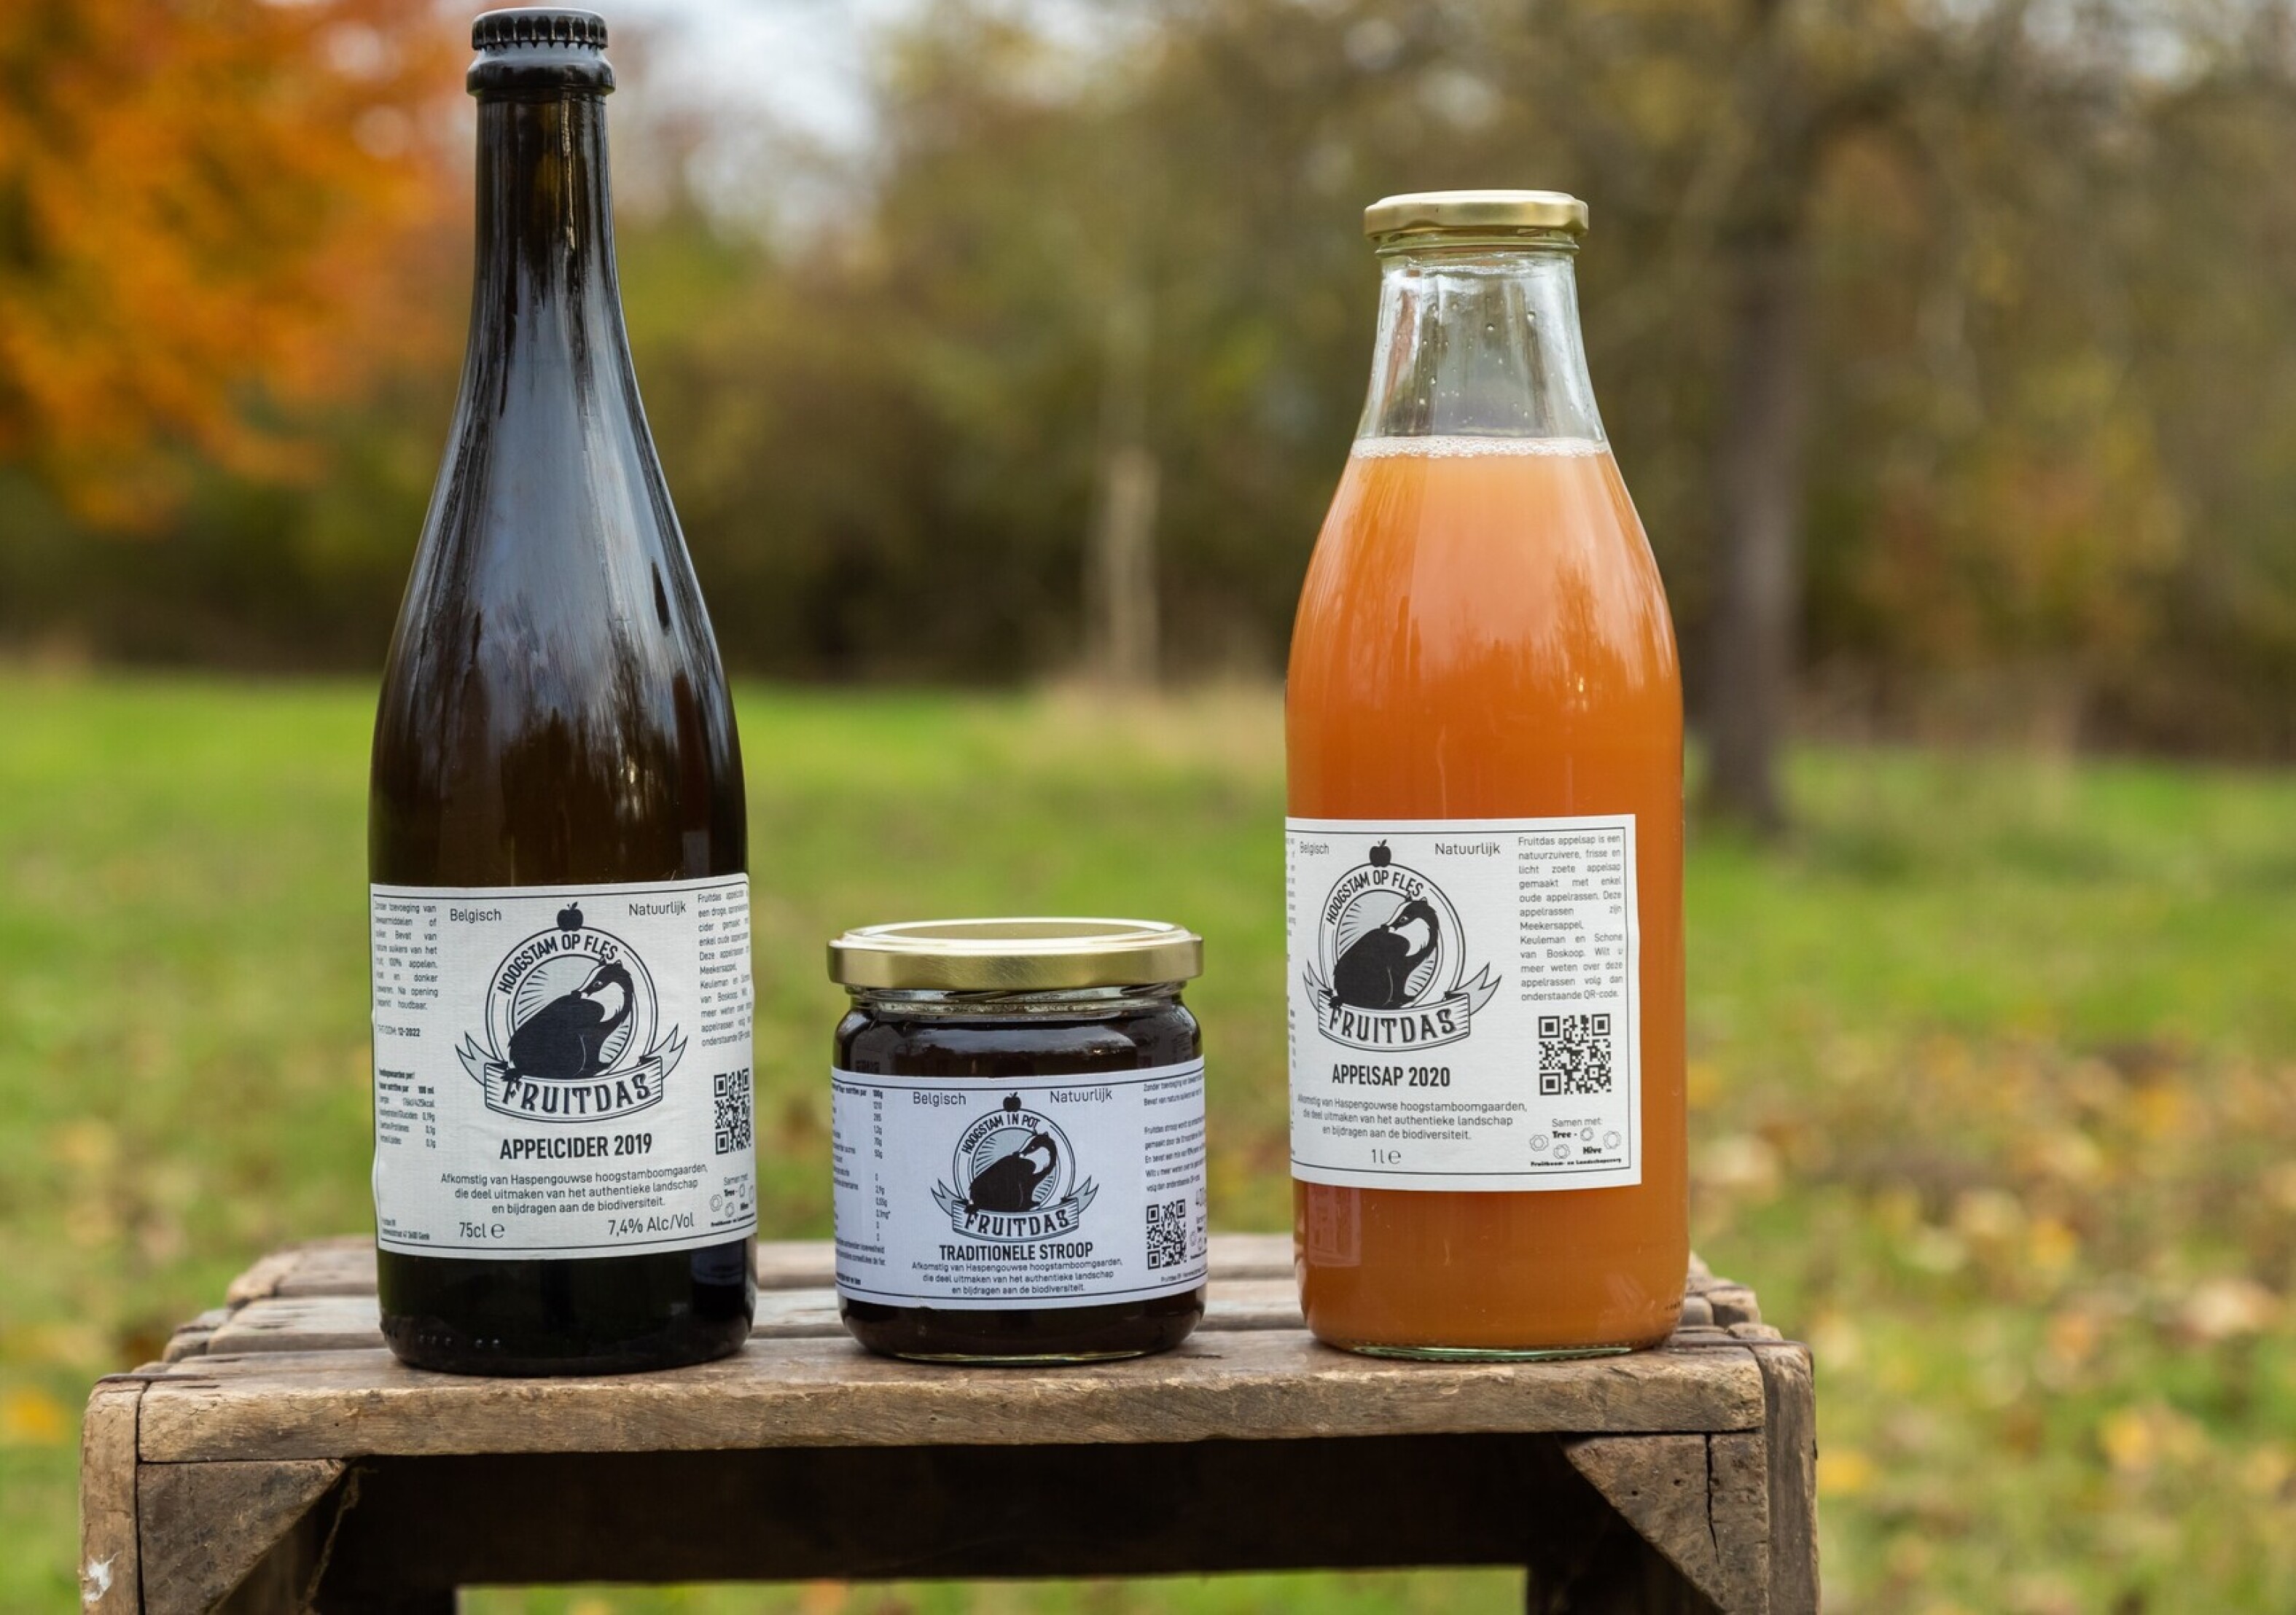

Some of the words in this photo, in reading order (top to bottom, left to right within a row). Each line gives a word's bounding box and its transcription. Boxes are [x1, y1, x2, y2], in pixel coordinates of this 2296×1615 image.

[1518, 836, 1555, 845] Fruitdas
[1558, 835, 1595, 845] appelsap
[1598, 835, 1604, 843] is
[1300, 841, 1329, 856] Belgisch
[1434, 842, 1501, 856] Natuurlijk
[1518, 865, 1539, 874] licht
[1552, 865, 1576, 873] zoete
[1587, 863, 1621, 872] appelsap
[1519, 879, 1558, 890] gemaakt
[1571, 878, 1589, 887] met
[1326, 871, 1370, 926] HOOGSTAM
[1372, 869, 1389, 885] OP
[1391, 872, 1424, 896] FLES
[1519, 893, 1542, 902] oude
[1604, 890, 1622, 900] Deze
[450, 909, 501, 923] Belgisch
[628, 901, 687, 915] Natuurlijk
[1520, 907, 1574, 917] appelrassen
[429, 918, 437, 927] of
[698, 923, 714, 932] cider
[1520, 936, 1566, 945] Keuleman
[1595, 933, 1623, 942] Schone
[425, 945, 437, 954] het
[700, 952, 715, 961] Deze
[497, 936, 558, 995] HOOGSTAM
[561, 934, 580, 950] OP
[584, 934, 618, 960] FLES
[1520, 965, 1545, 973] meer
[1551, 963, 1578, 971] weten
[413, 973, 437, 982] donker
[1521, 978, 1575, 988] appelrassen
[411, 988, 438, 998] opening
[1521, 991, 1582, 1001] onderstaande
[1329, 1008, 1456, 1044] FRUITDAS
[1409, 1066, 1450, 1087] 2020
[501, 1074, 650, 1114] FRUITDAS
[913, 1092, 966, 1107] Belgisch
[1050, 1087, 1112, 1103] Natuurlijk
[1144, 1098, 1157, 1106] Bevat
[1335, 1098, 1398, 1111] Haspengouwse
[1401, 1101, 1527, 1114] hoogstamboomgaarden,
[1324, 1112, 1357, 1122] uitmaken
[1377, 1114, 1391, 1125] het
[1394, 1117, 1455, 1126] authentieke
[1458, 1116, 1512, 1127] landschap
[1553, 1119, 1582, 1127] Samen
[962, 1115, 1004, 1154] HOOGSTAM
[1007, 1114, 1019, 1125] IN
[1022, 1114, 1040, 1129] POT
[1322, 1126, 1330, 1134] en
[1332, 1125, 1367, 1138] bijdragen
[1389, 1129, 1399, 1138] de
[1402, 1130, 1472, 1140] biodiversiteit.
[1553, 1130, 1571, 1138] Tree
[614, 1133, 652, 1157] 2019
[441, 1173, 487, 1186] Afkomstig
[491, 1176, 508, 1184] van
[511, 1174, 593, 1186] Haspengouwse
[596, 1164, 708, 1182] hoogstamboomgaarden,
[455, 1189, 469, 1198] die
[471, 1189, 492, 1199] deel
[494, 1189, 544, 1200] uitmaken
[547, 1190, 565, 1198] van
[568, 1187, 586, 1197] het
[589, 1184, 650, 1197] authentieke
[653, 1178, 698, 1193] landschap
[492, 1205, 504, 1213] en
[507, 1203, 556, 1216] bijdragen
[559, 1205, 579, 1213] aan
[582, 1202, 595, 1213] de
[598, 1197, 665, 1211] biodiversiteit.
[458, 1222, 487, 1238] 75cl
[608, 1219, 643, 1237] 7,4%
[647, 1212, 694, 1232] Alc/Vol
[964, 1210, 1069, 1237] FRUITDAS
[939, 1245, 1036, 1262] TRADITIONELE
[1040, 1241, 1093, 1259] STROOP
[912, 1262, 948, 1272] Afkomstig
[966, 1264, 1028, 1273] Haspengouwse
[923, 1274, 934, 1282] die
[935, 1275, 952, 1283] deel
[953, 1275, 991, 1283] uitmaken
[1025, 1272, 1073, 1283] authentieke
[1074, 1270, 1114, 1280] landschap
[963, 1286, 1001, 1296] bijdragen
[1019, 1286, 1029, 1294] de
